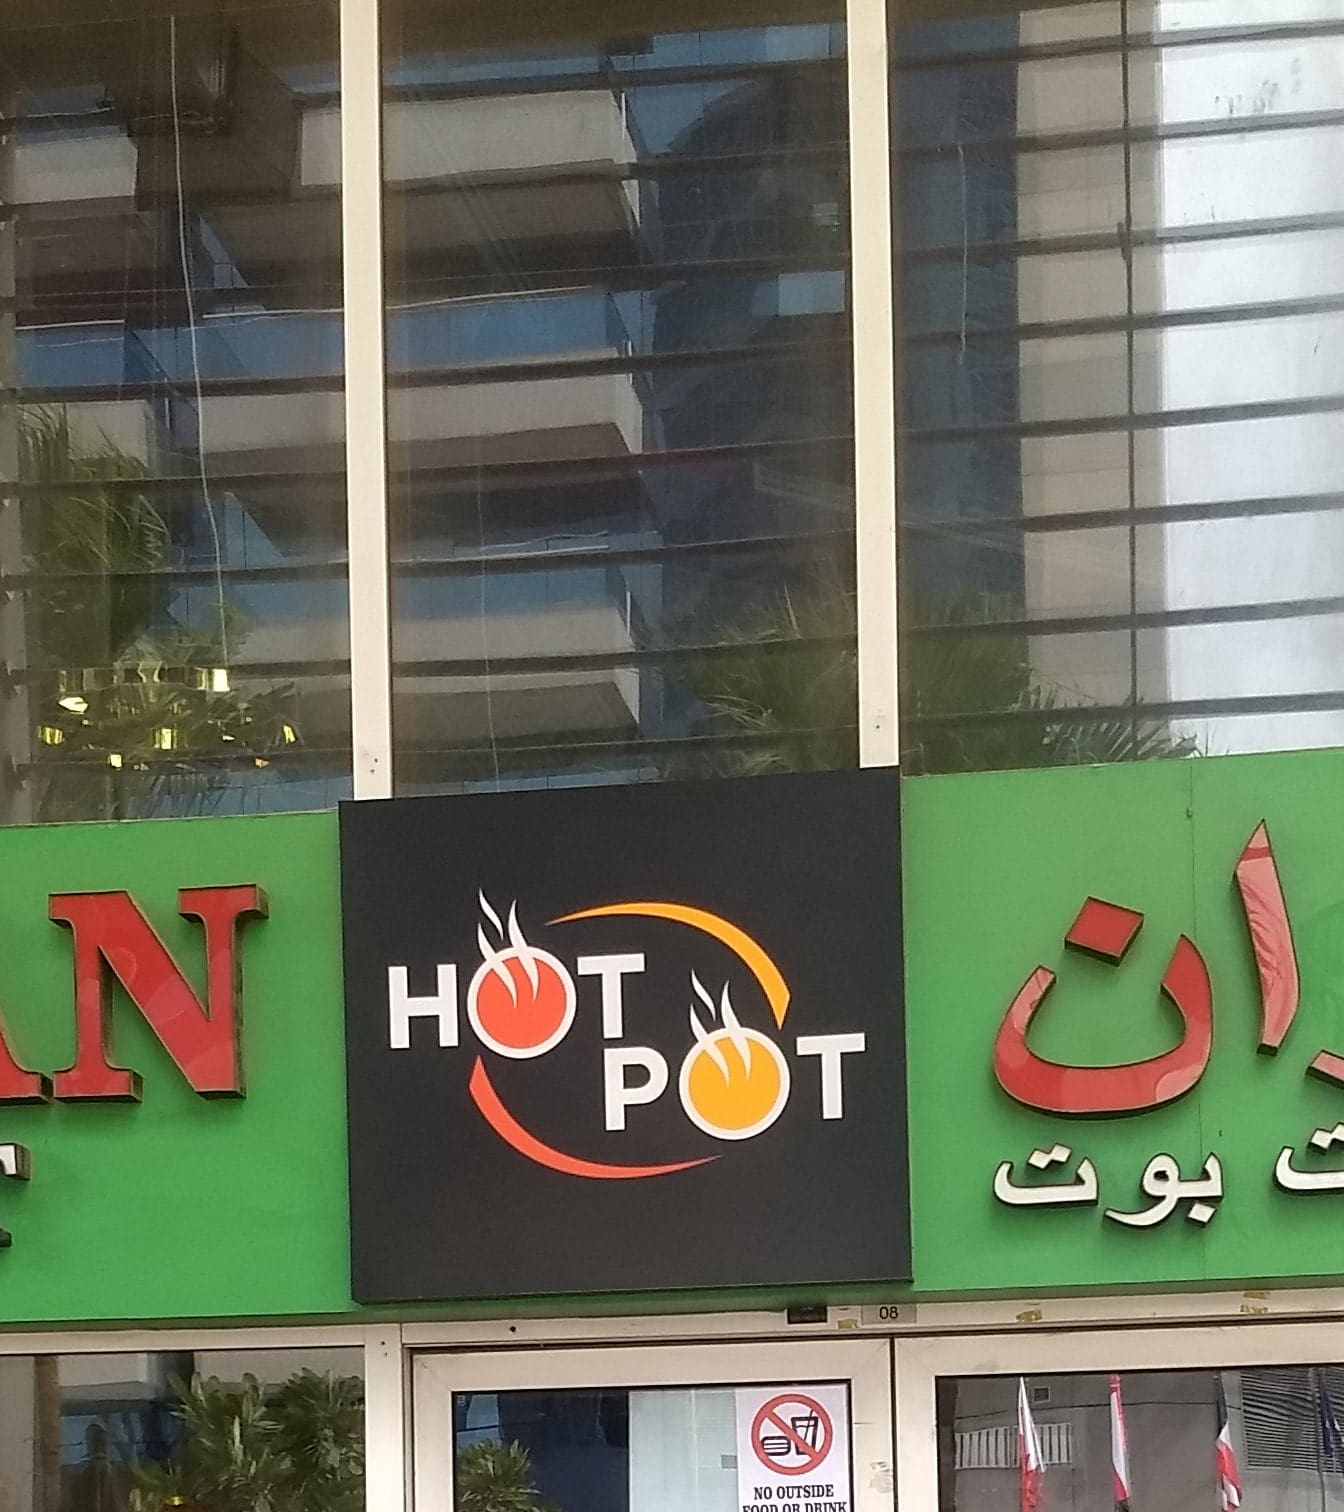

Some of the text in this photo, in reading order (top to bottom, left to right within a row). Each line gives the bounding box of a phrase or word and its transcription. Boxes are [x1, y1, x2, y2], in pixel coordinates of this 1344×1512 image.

[387, 943, 646, 1060] HOT
[603, 1026, 866, 1142] POT
[992, 1143, 1224, 1228] بوت
[878, 1306, 899, 1320] 08
[753, 1484, 834, 1500] NO OUTSIDE
